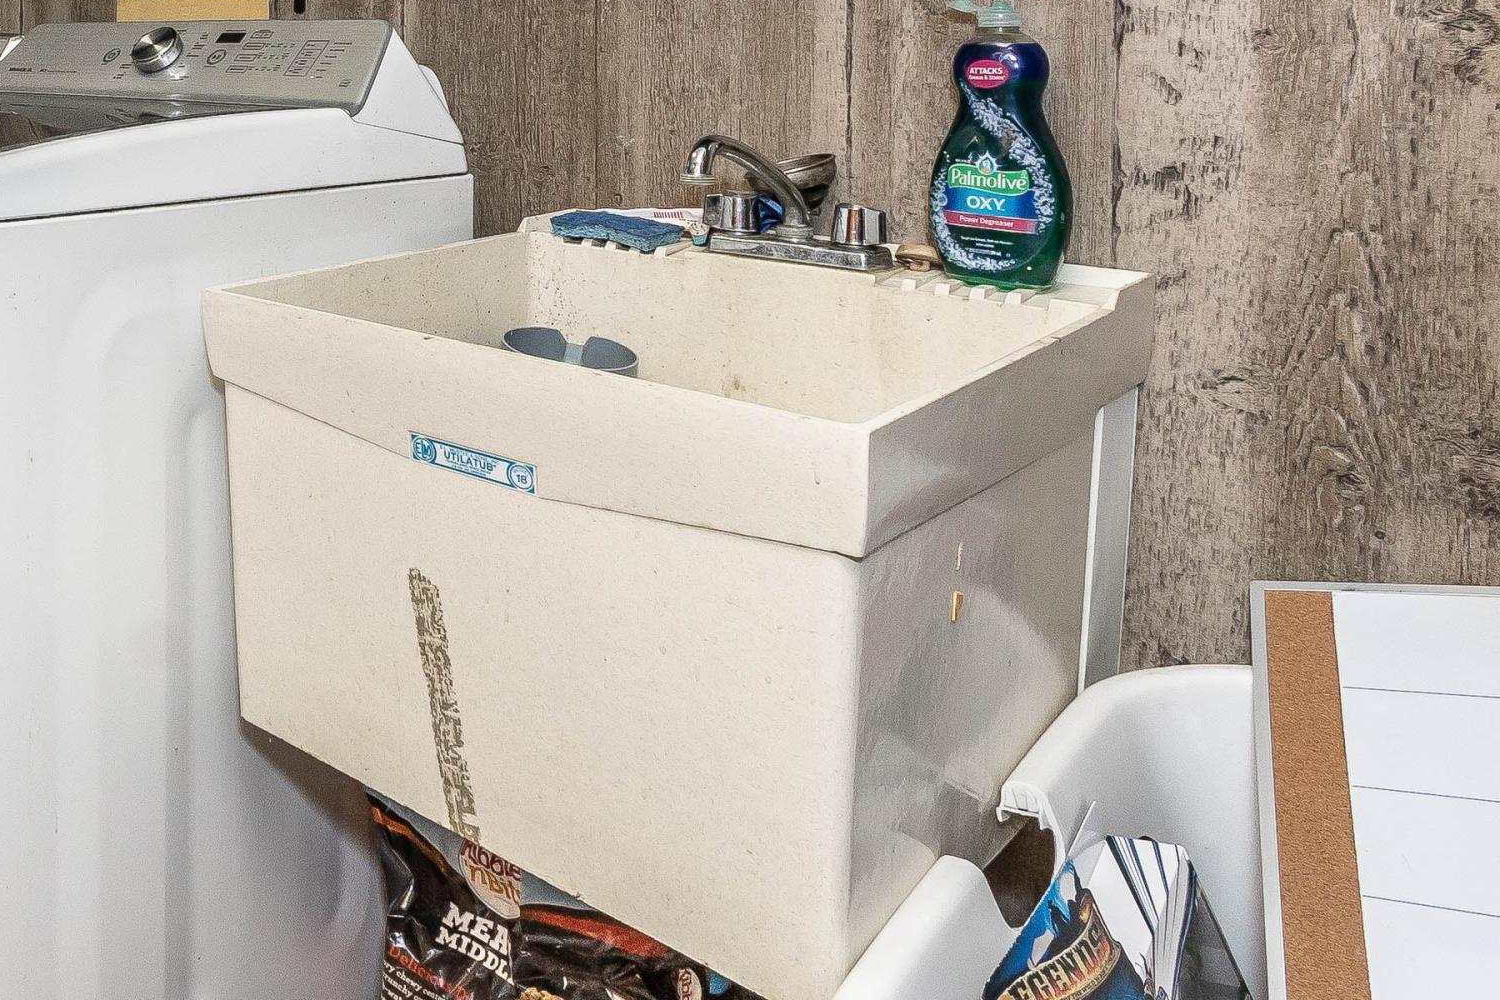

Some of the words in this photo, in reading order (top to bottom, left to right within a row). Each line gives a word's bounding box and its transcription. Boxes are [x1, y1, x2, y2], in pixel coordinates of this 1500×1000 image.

[969, 67, 1003, 75] ATTACKS
[951, 168, 1028, 190] Palmolive
[966, 195, 1006, 211] OXY
[959, 215, 979, 223] Power
[979, 218, 1014, 228] Degreaser
[442, 451, 494, 472] UTILATUB
[515, 473, 528, 485] 18
[441, 901, 510, 956] MEA
[435, 926, 514, 986] MIDDL
[1008, 923, 1110, 1000] EGENDS
[396, 970, 423, 992] chewy
